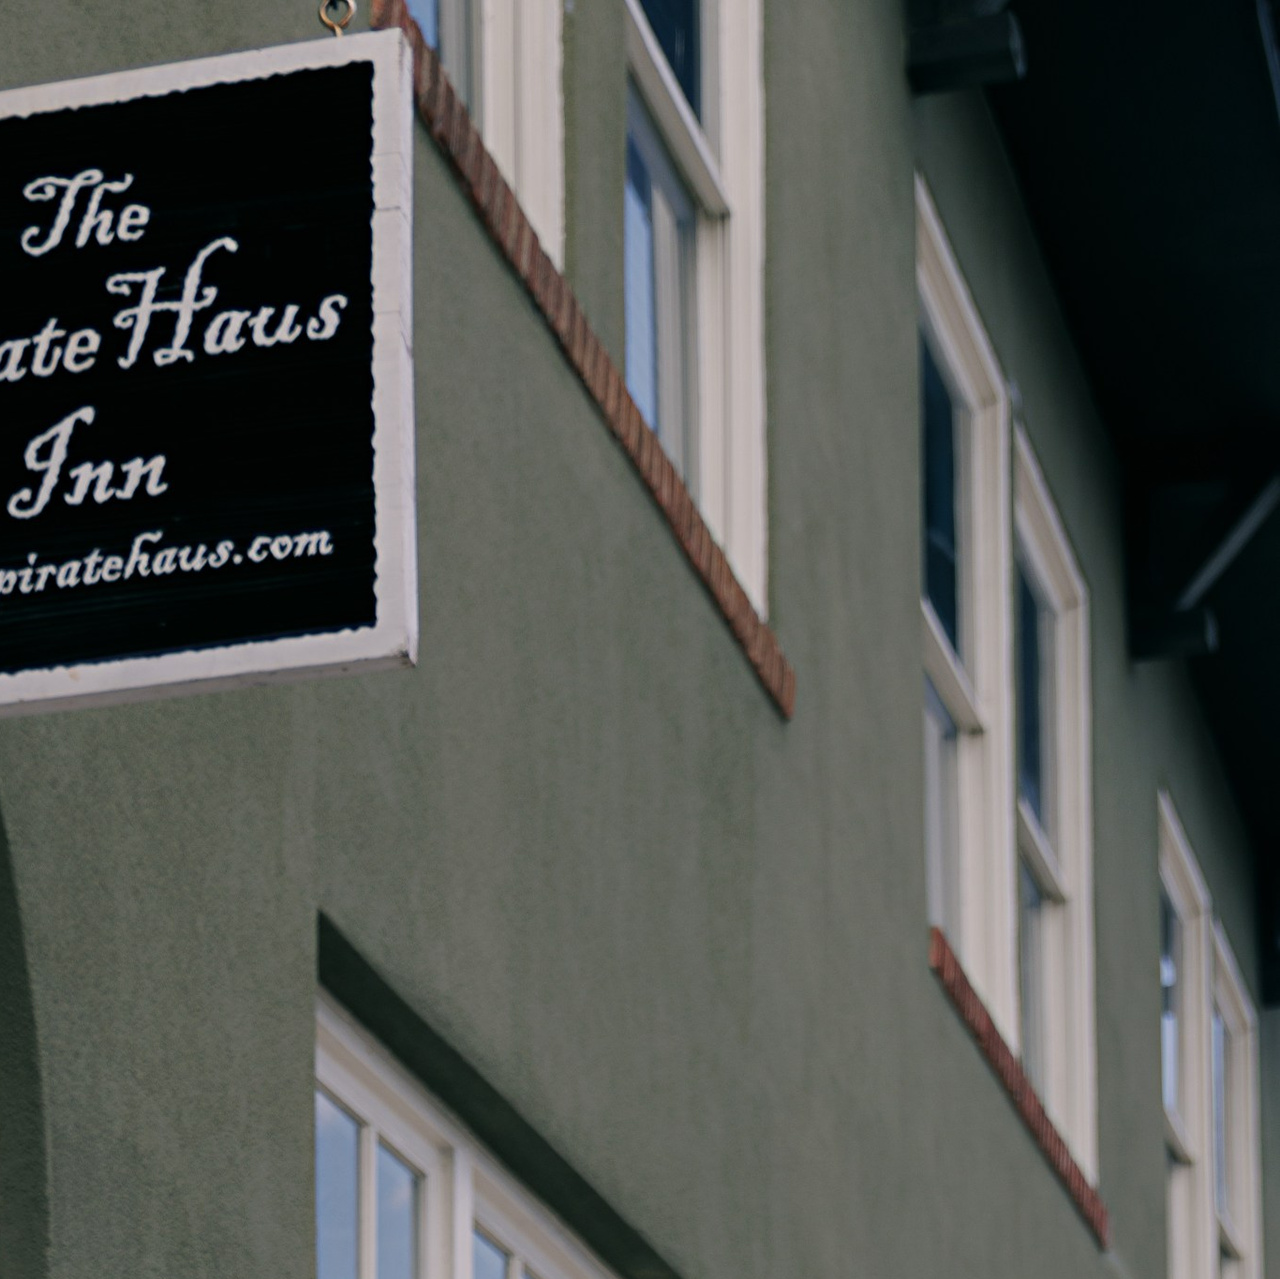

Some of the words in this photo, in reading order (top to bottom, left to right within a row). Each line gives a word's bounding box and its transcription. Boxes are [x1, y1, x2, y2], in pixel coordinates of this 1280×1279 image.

[22, 169, 150, 256] The
[106, 237, 347, 368] Haus
[8, 406, 167, 518] Inn
